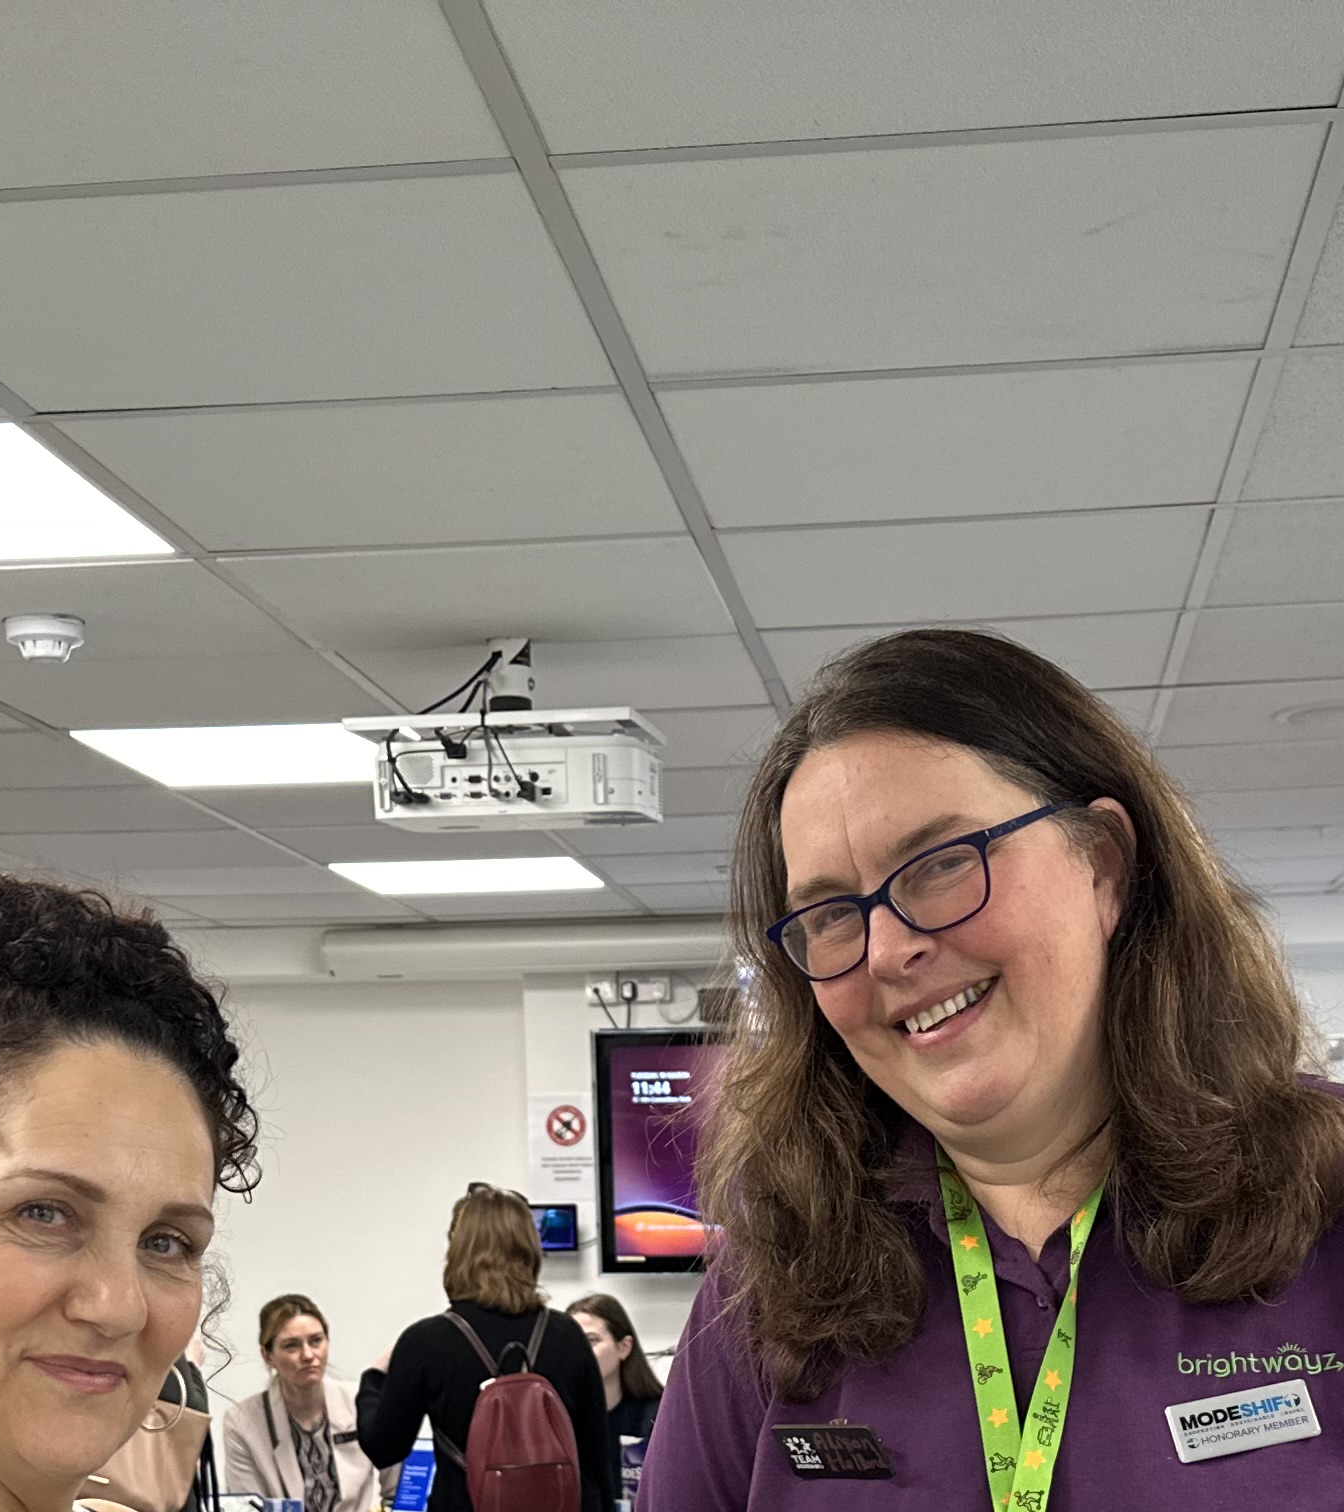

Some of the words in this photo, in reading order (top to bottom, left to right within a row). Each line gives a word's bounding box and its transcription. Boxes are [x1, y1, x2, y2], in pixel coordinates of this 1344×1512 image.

[1177, 1351, 1344, 1377] brightwayz
[1201, 1426, 1260, 1445] HONORARY
[1264, 1415, 1309, 1432] MEMBER
